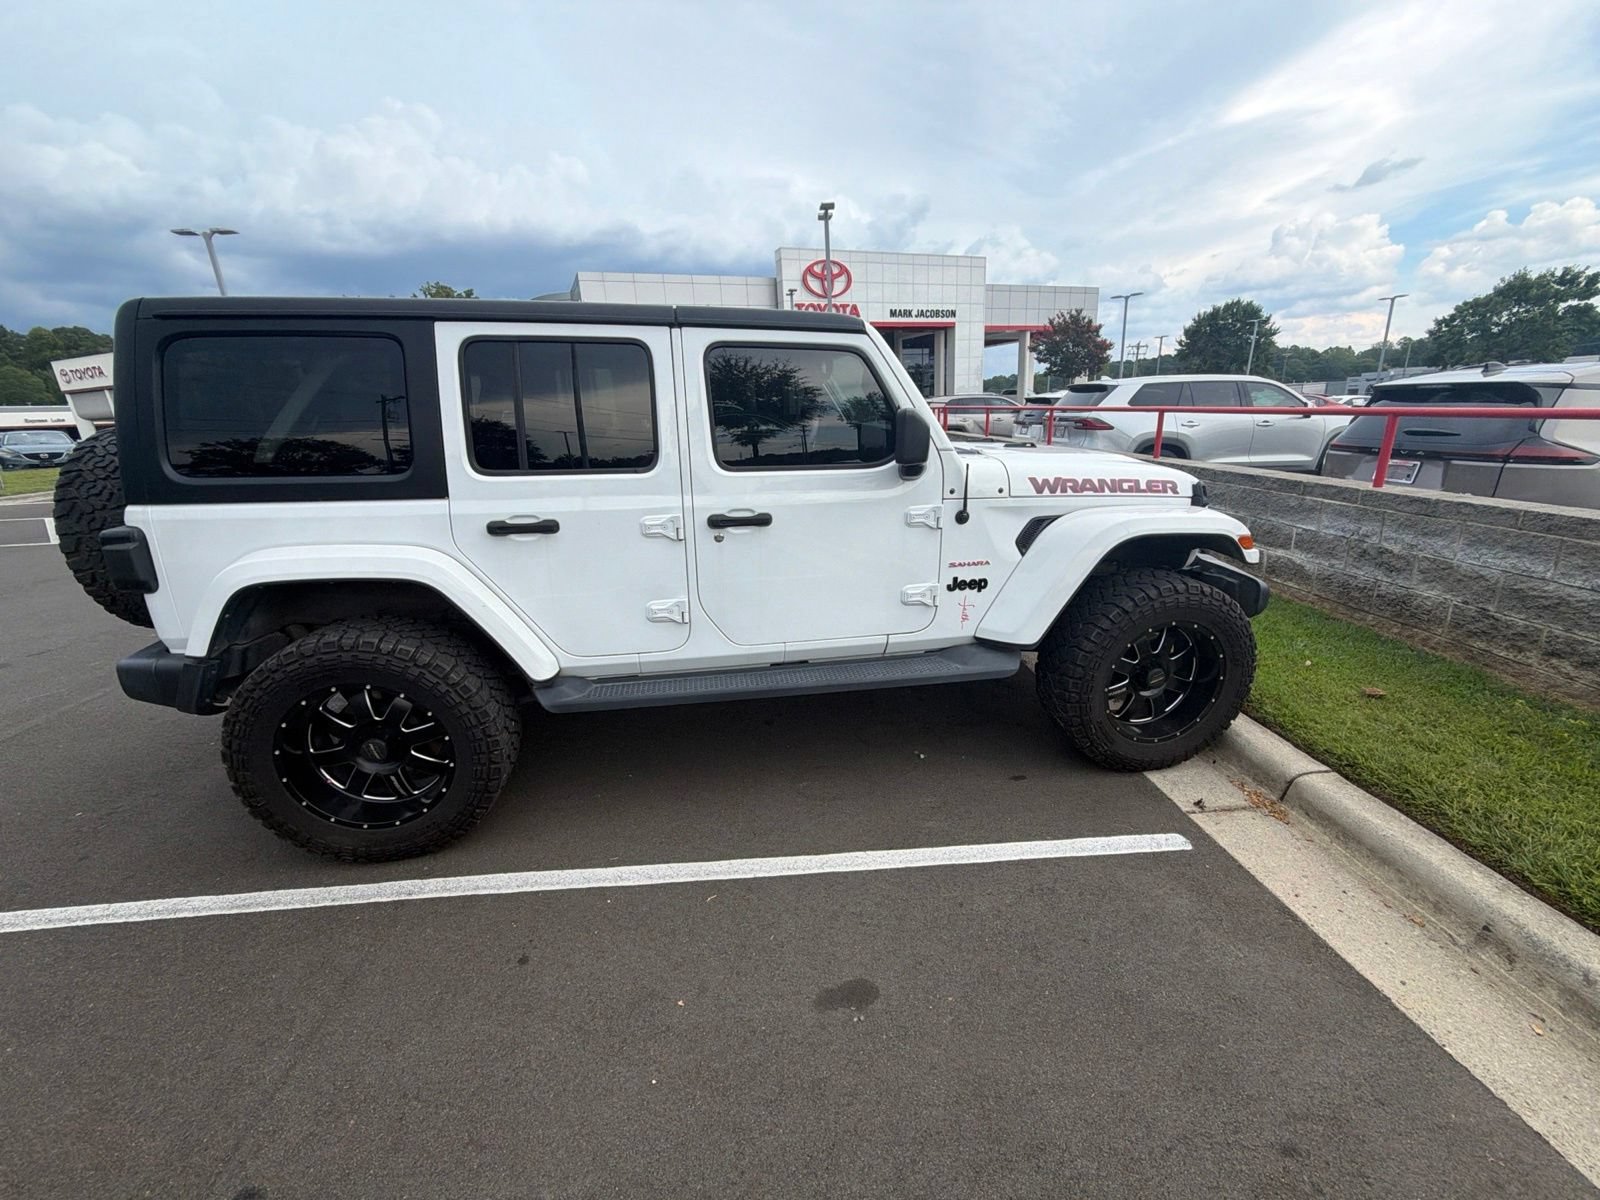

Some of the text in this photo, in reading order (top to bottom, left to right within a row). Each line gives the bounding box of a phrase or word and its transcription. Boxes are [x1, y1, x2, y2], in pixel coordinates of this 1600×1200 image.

[889, 309, 956, 319] MARK JACOBSON
[69, 365, 107, 381] TOYOTA
[1028, 476, 1180, 495] WRANGLER
[948, 560, 990, 568] SAHARA
[946, 576, 988, 593] Jeep
